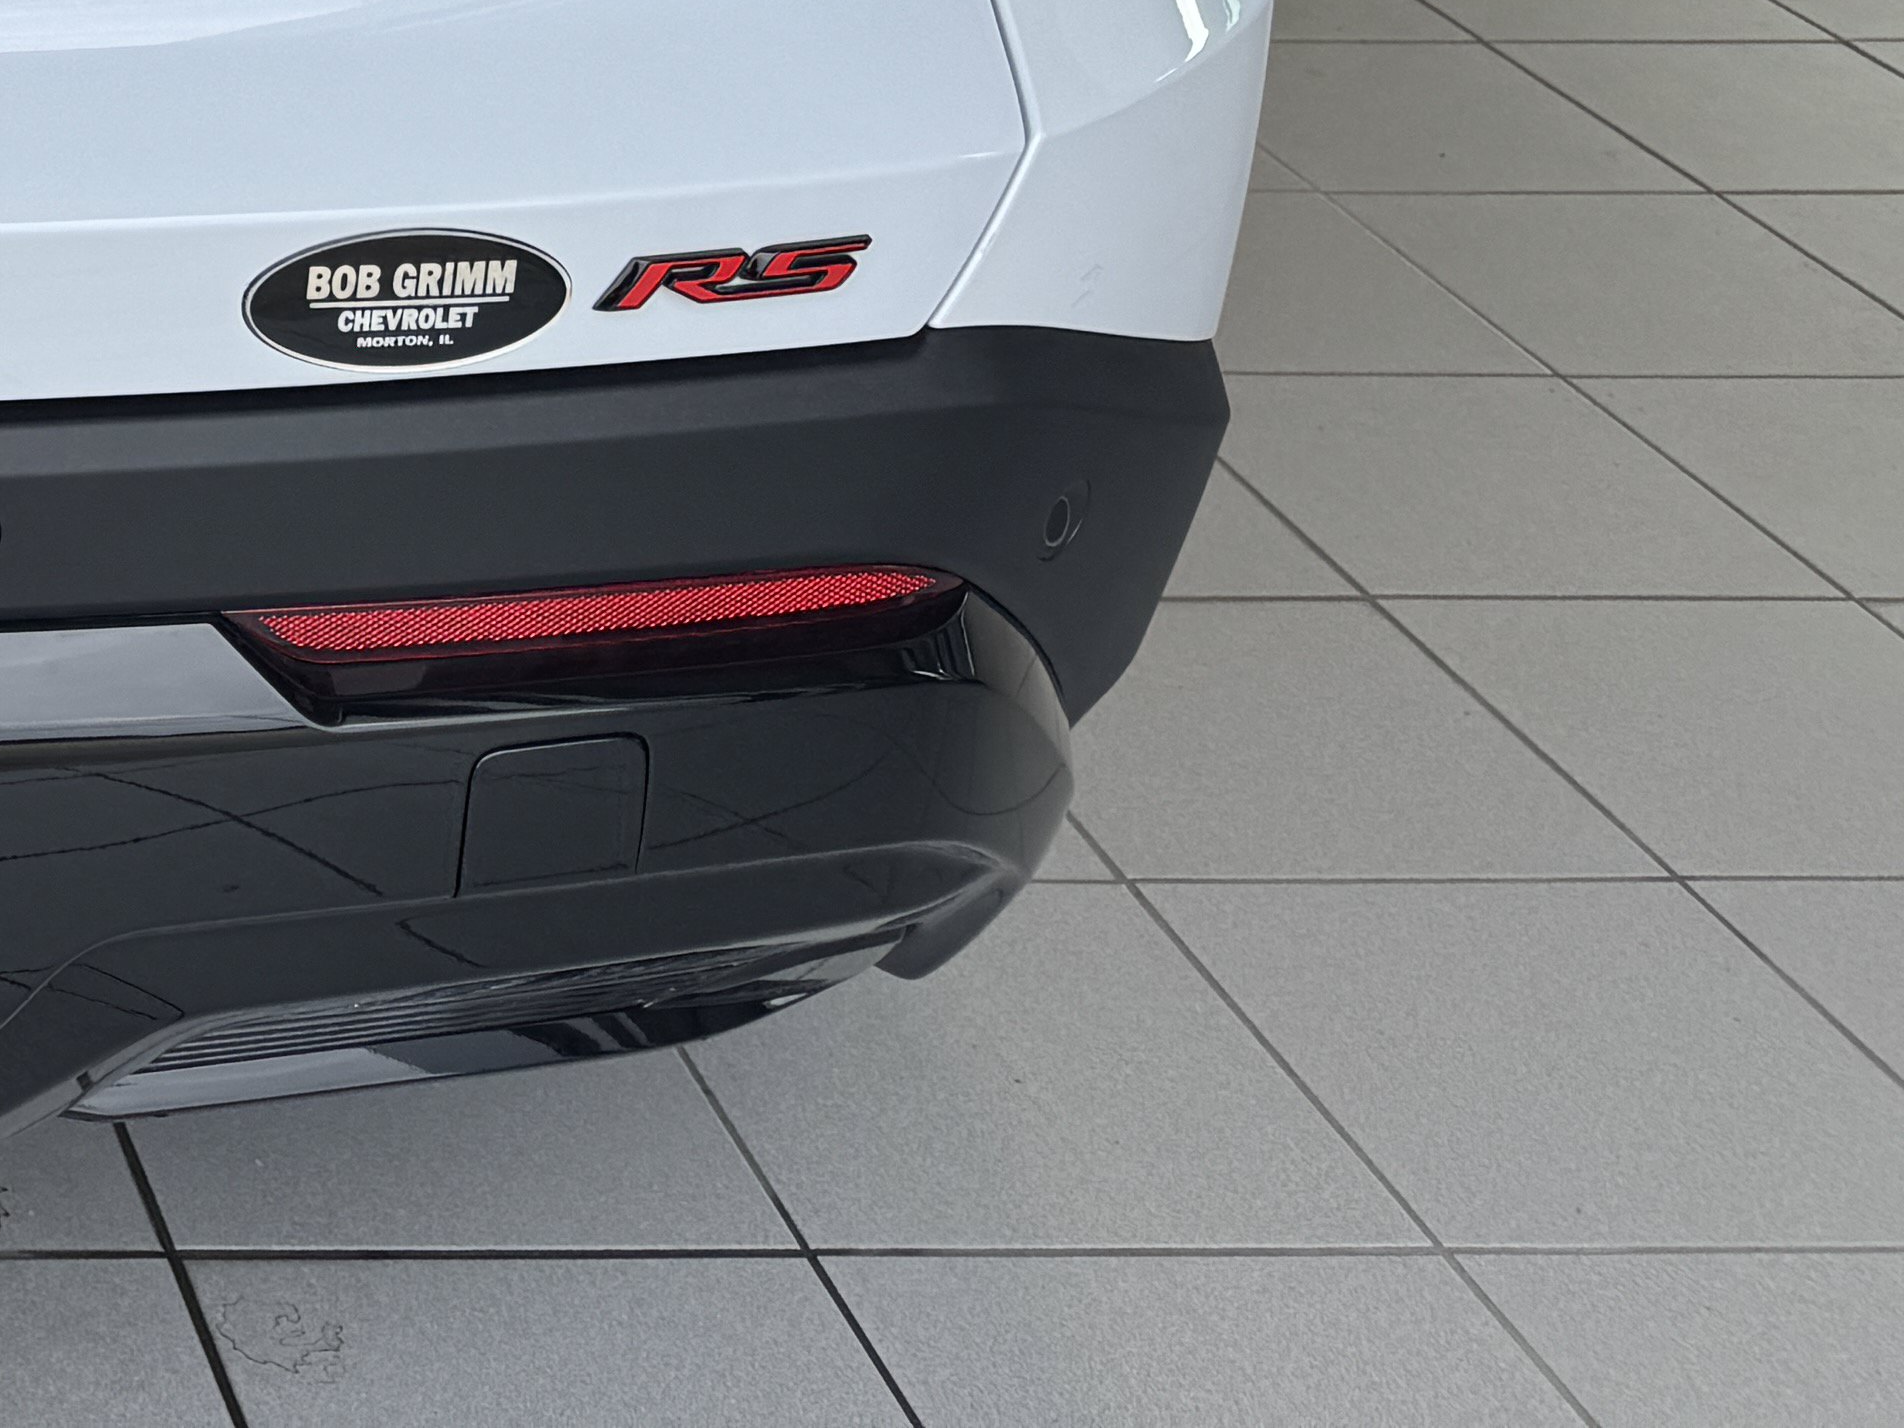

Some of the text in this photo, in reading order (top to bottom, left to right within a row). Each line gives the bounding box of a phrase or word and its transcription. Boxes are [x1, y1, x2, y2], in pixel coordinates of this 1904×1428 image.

[305, 259, 518, 300] BOB GRIMM
[592, 233, 873, 312] RS
[336, 306, 479, 333] CHEVROLET
[356, 334, 454, 348] MORTON, IL
